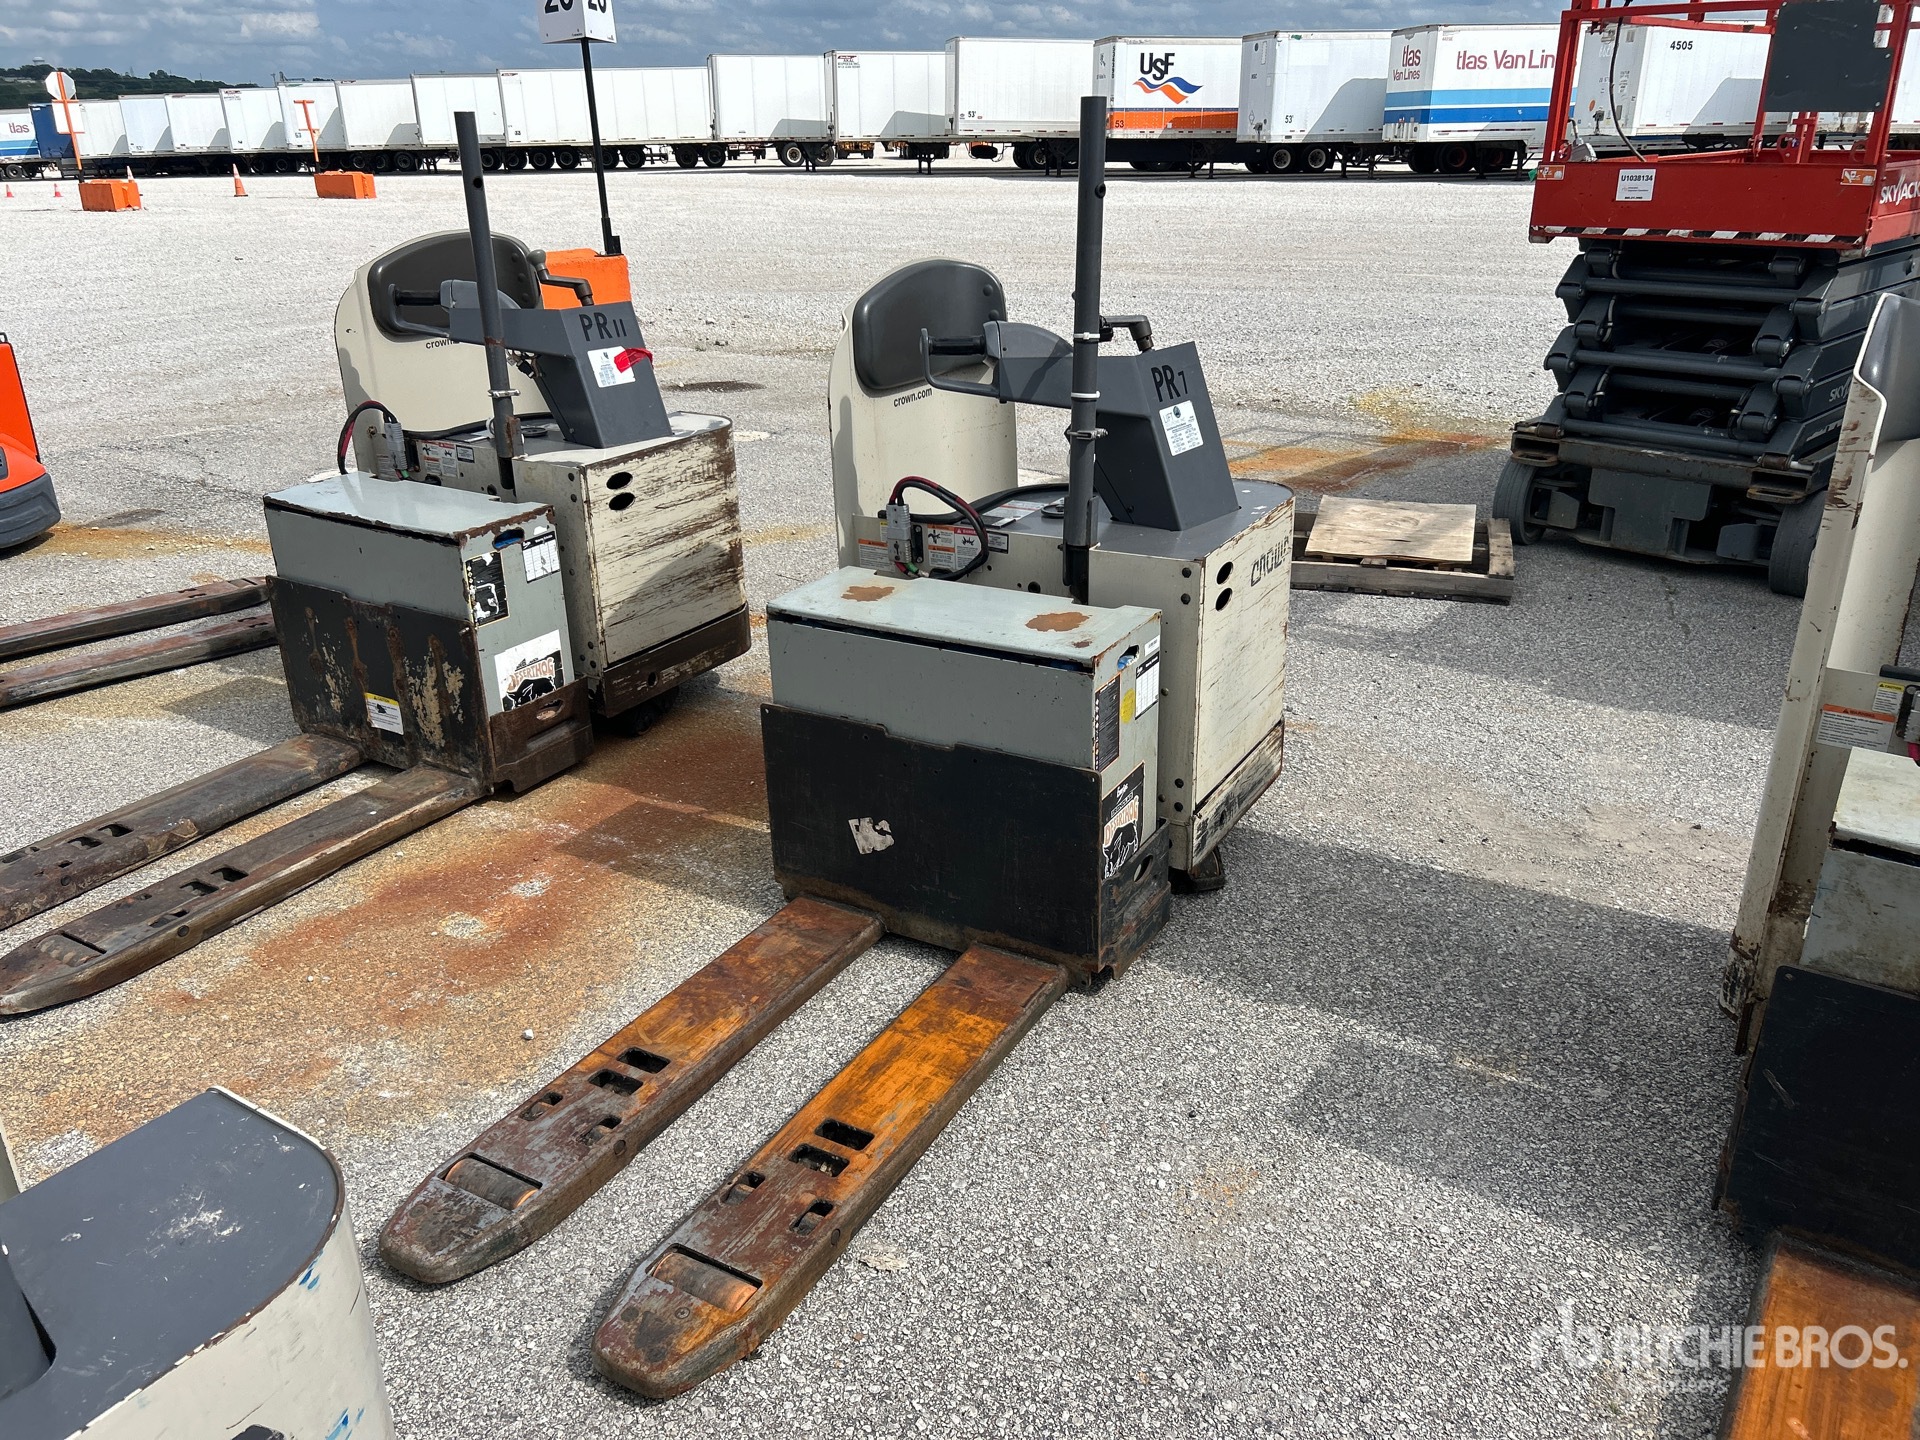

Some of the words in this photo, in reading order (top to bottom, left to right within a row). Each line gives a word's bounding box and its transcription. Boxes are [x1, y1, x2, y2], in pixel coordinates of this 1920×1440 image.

[1669, 41, 1693, 50] 4505
[1402, 45, 1421, 67] tlas
[1456, 50, 1487, 70] tlas
[1493, 50, 1526, 70] Van
[1528, 49, 1556, 69] Lin
[1139, 52, 1175, 81] USF
[1393, 69, 1404, 82] Van
[1404, 69, 1421, 81] Lines
[1114, 120, 1125, 128] 53
[1879, 173, 1920, 206] SKYJACK
[893, 388, 933, 408] crown.com
